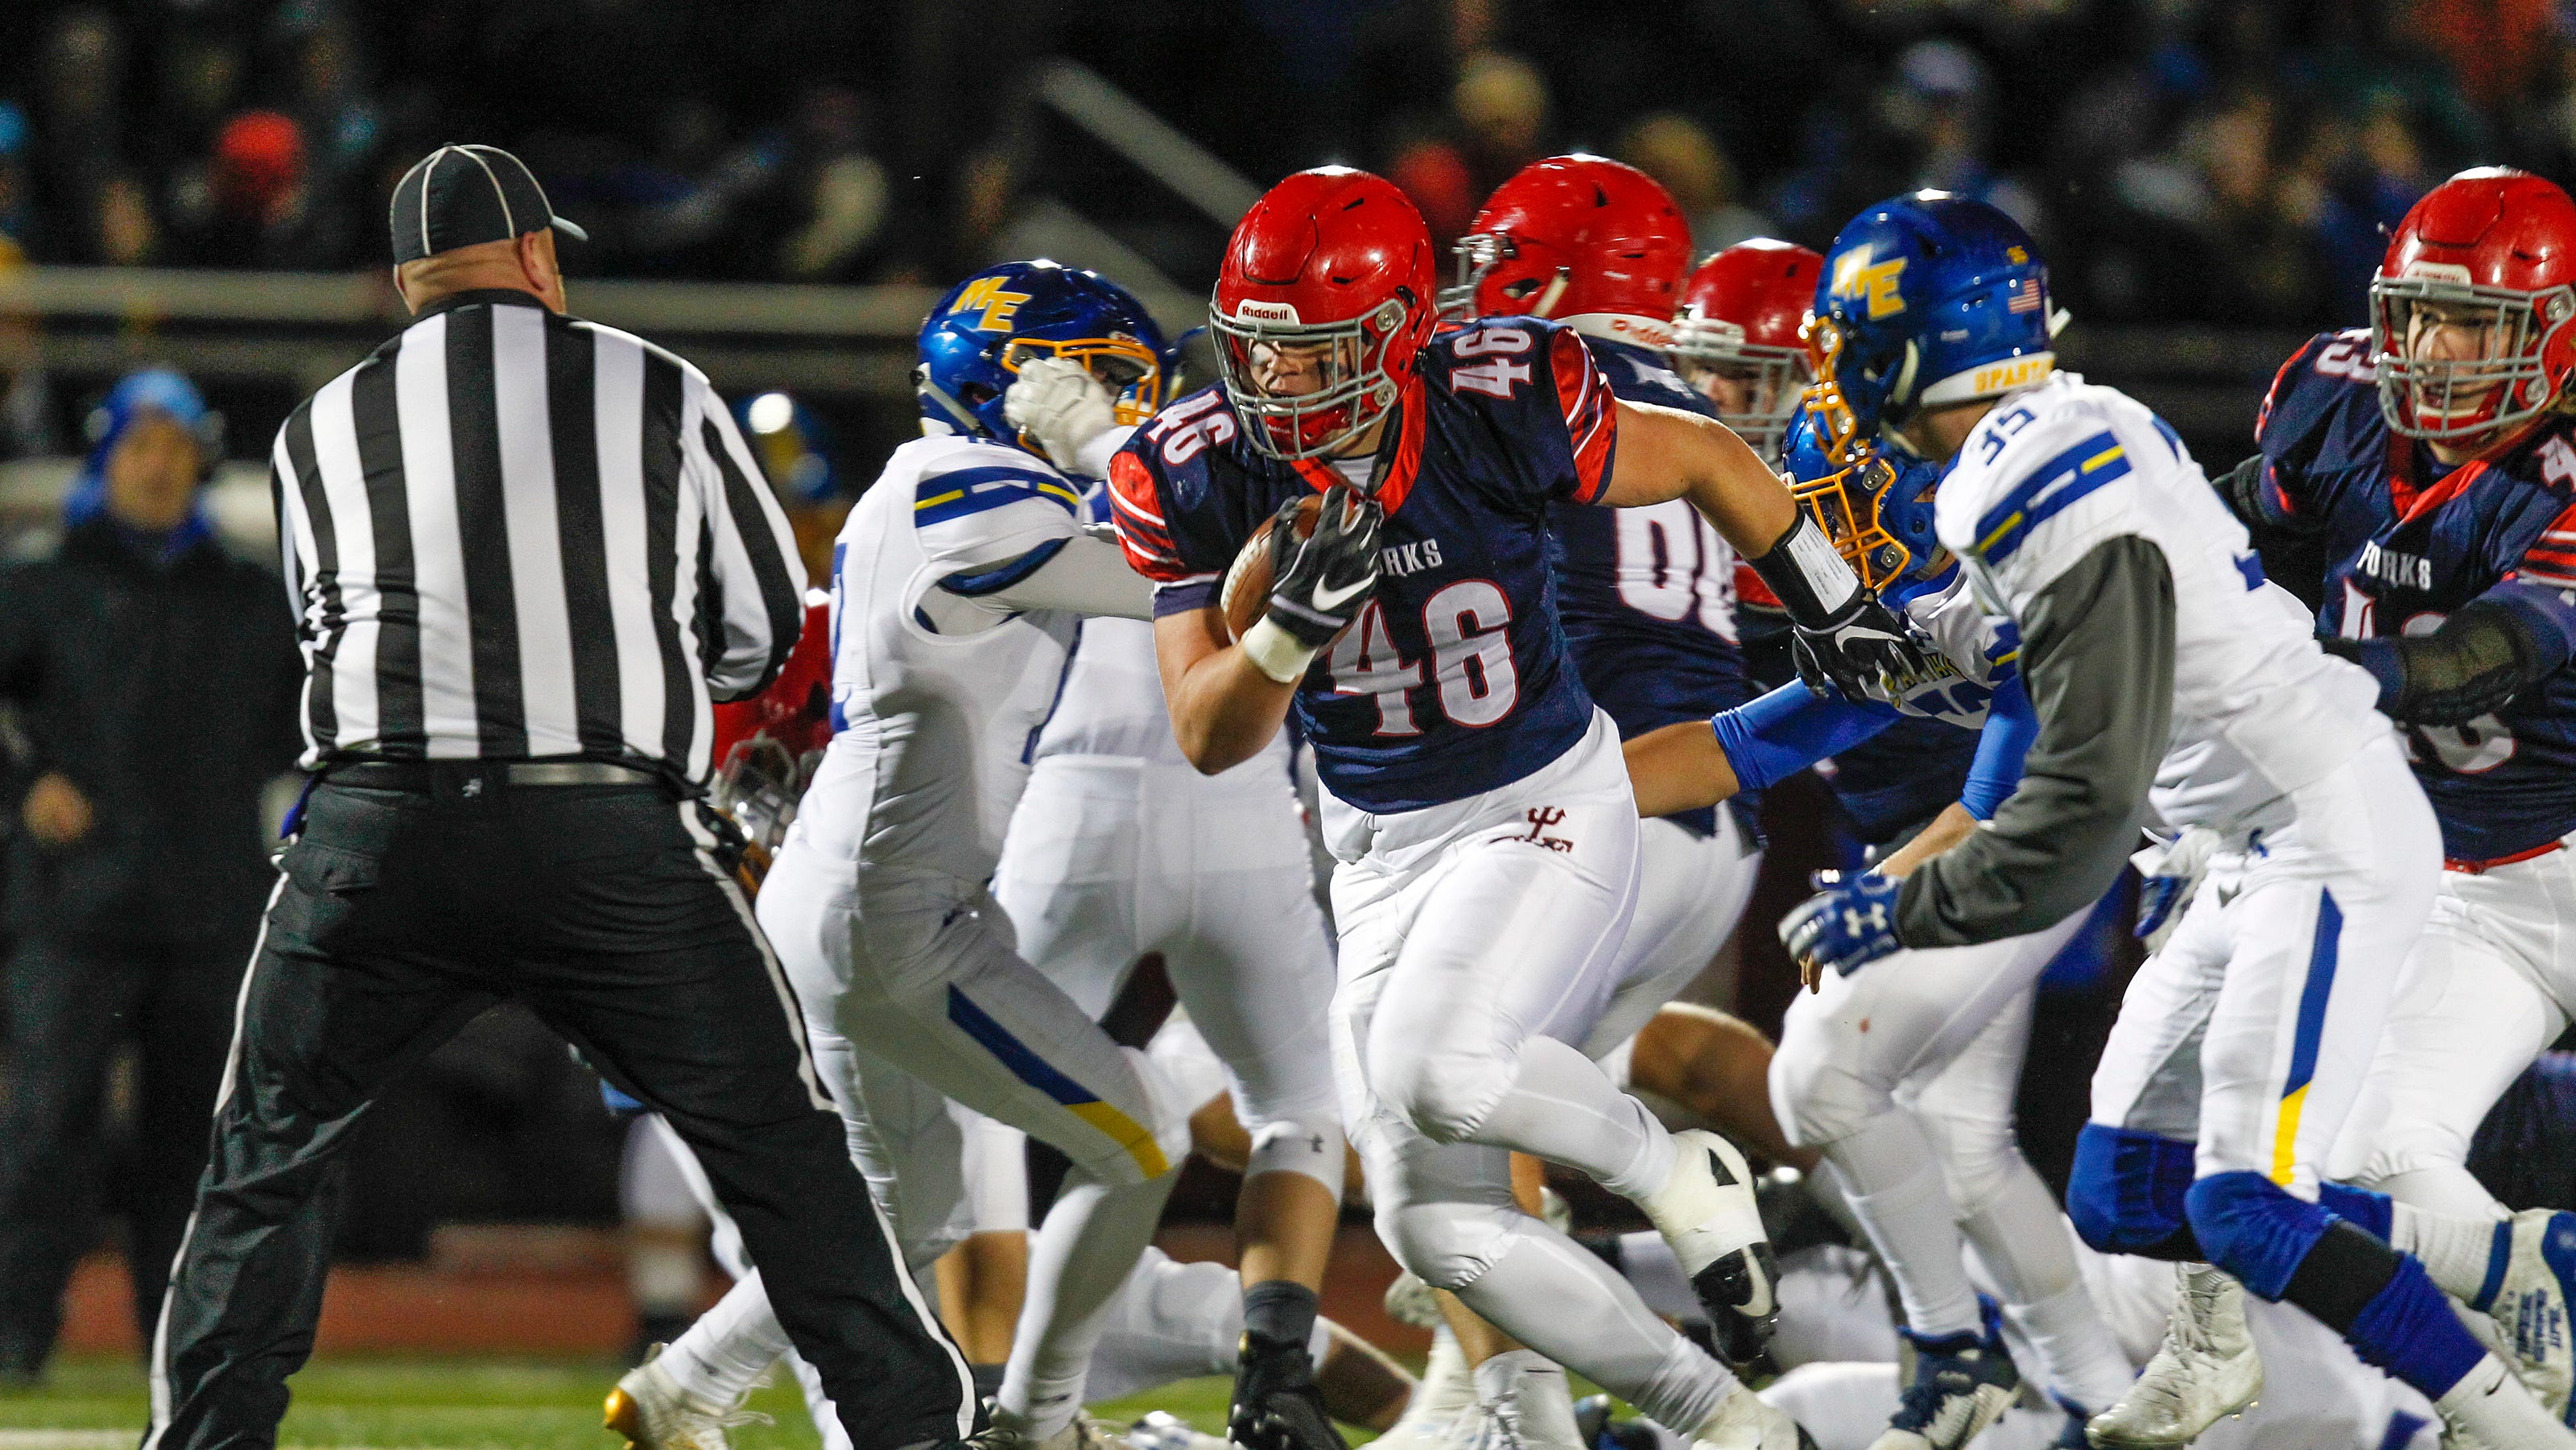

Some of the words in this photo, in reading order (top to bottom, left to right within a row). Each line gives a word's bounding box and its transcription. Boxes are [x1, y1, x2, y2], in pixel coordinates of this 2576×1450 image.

[948, 276, 1032, 333] ME
[1242, 306, 1288, 320] Riddell
[1830, 242, 1909, 320] ME
[1450, 328, 1534, 400] 46
[1145, 389, 1237, 466] 46
[1981, 408, 2037, 465] 35
[1377, 538, 1443, 577] RKS
[1326, 580, 1519, 737] 46
